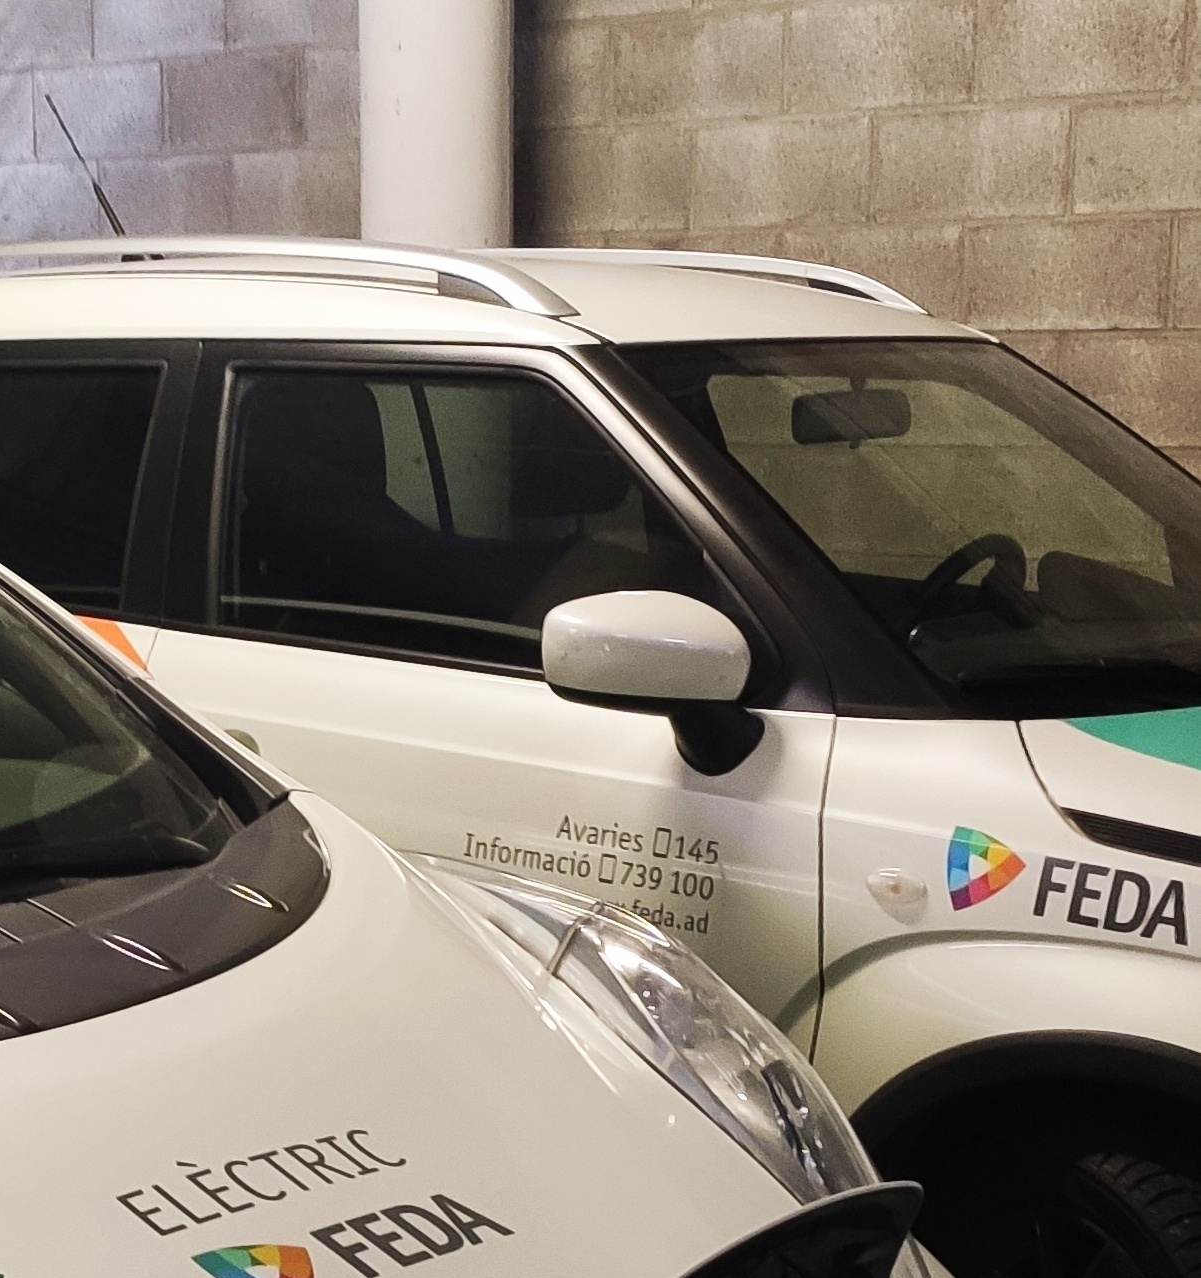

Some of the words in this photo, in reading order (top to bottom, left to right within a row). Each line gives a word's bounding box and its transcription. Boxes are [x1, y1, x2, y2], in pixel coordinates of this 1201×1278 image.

[463, 832, 592, 878] Informació
[620, 861, 662, 890] 739
[670, 870, 715, 900] 100
[556, 815, 645, 852] Avaries
[616, 899, 710, 934] feda.ad
[1033, 856, 1189, 946] FEDA
[116, 1129, 407, 1236] ELÈCTRIC
[309, 1193, 516, 1278] FEDA
